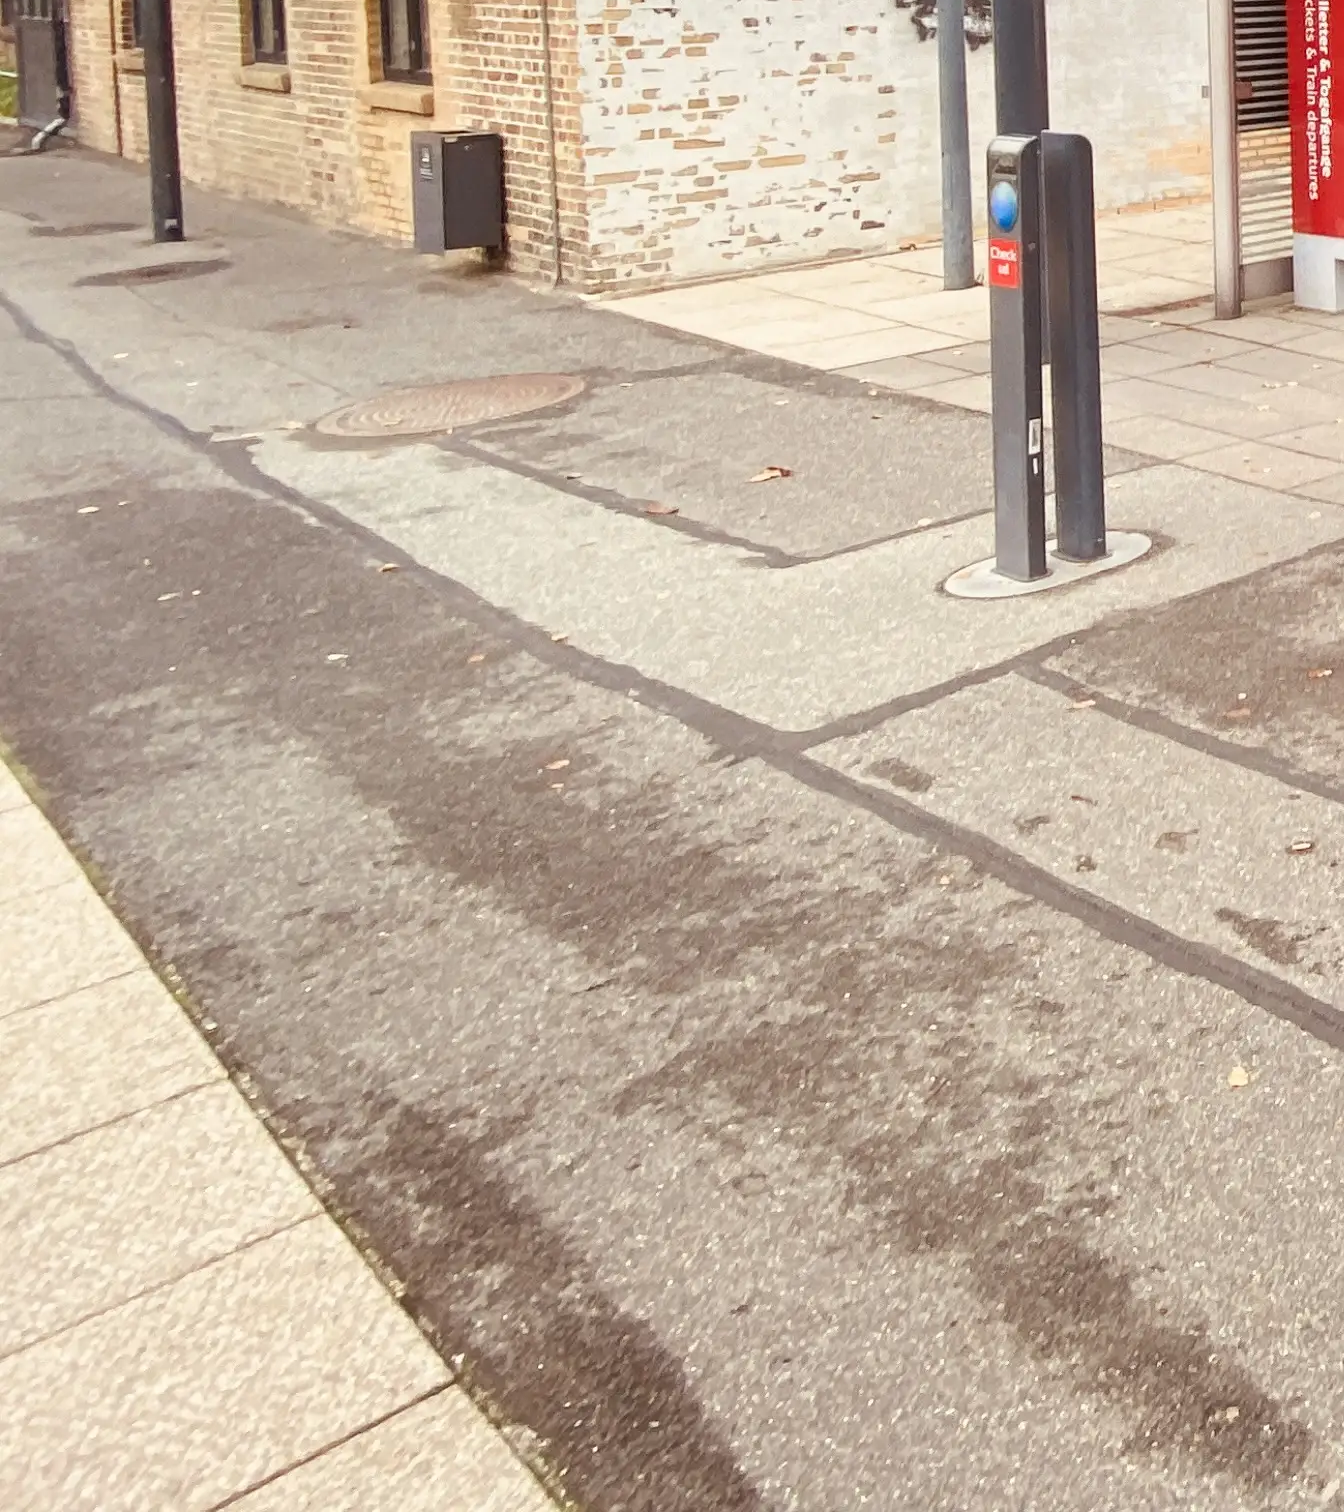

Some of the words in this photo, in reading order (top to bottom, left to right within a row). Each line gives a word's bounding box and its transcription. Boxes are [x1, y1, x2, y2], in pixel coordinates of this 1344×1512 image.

[1306, 48, 1317, 60] &
[1320, 58, 1331, 72] &
[1306, 65, 1318, 106] Train
[1319, 76, 1333, 178] Togafgange
[1306, 110, 1319, 201] departures
[991, 246, 1016, 261] Check
